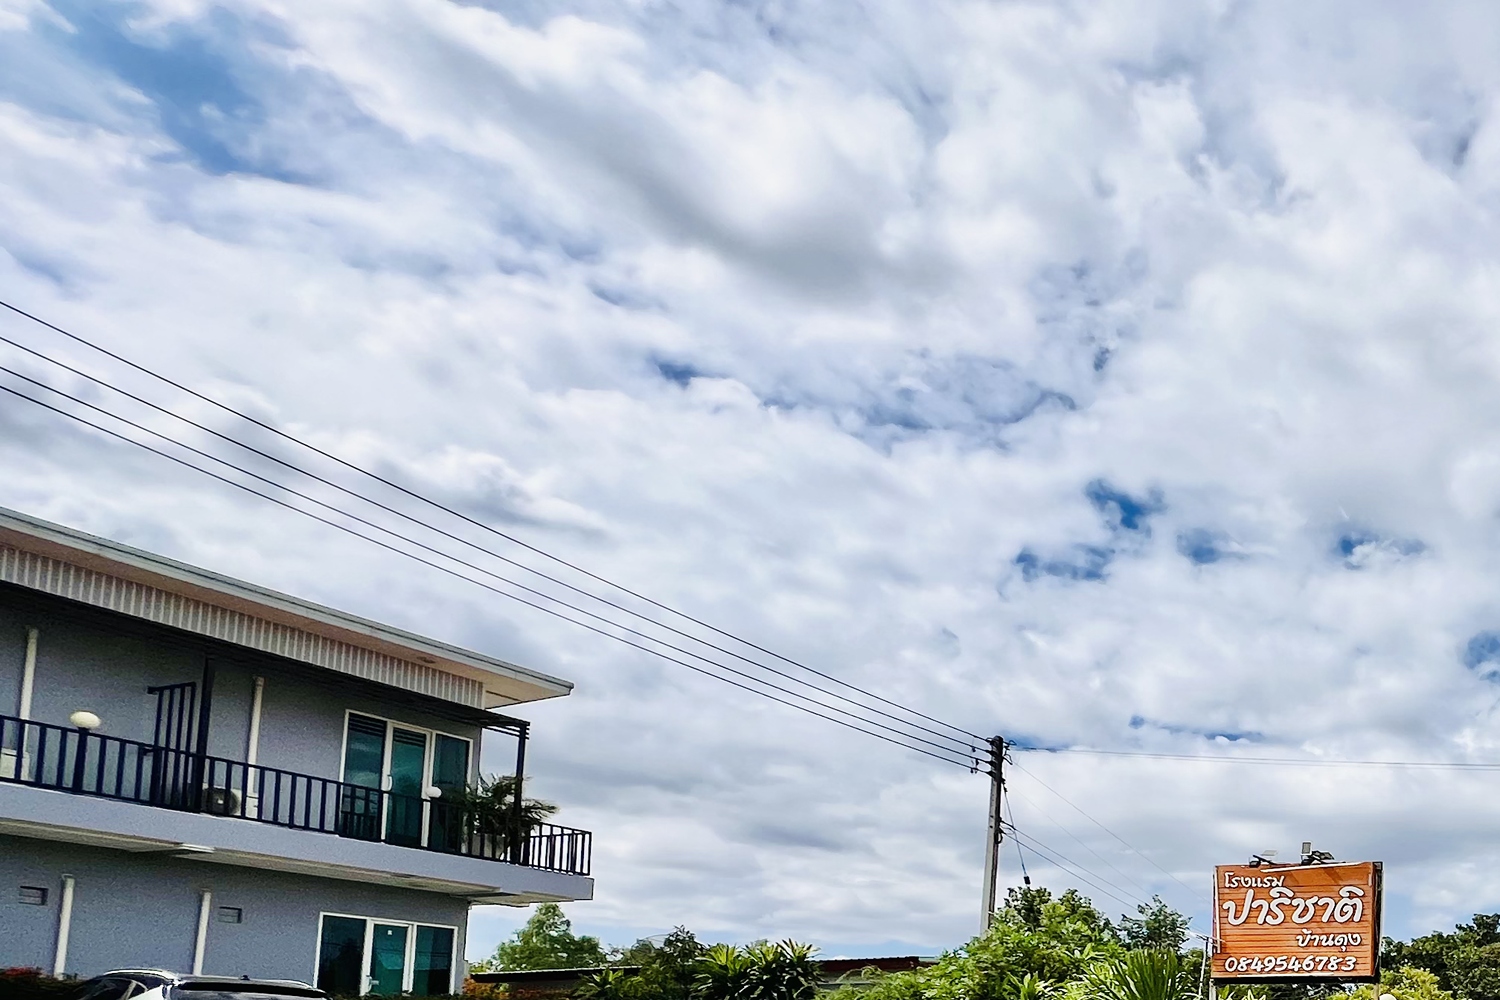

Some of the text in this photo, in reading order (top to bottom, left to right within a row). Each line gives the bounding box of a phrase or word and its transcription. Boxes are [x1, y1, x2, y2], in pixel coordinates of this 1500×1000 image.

[1224, 872, 1285, 888] โรงแรม
[1222, 886, 1365, 926] ปาริชาติ
[1296, 928, 1362, 952] บ้านดุง
[1224, 955, 1357, 973] 0849546783
